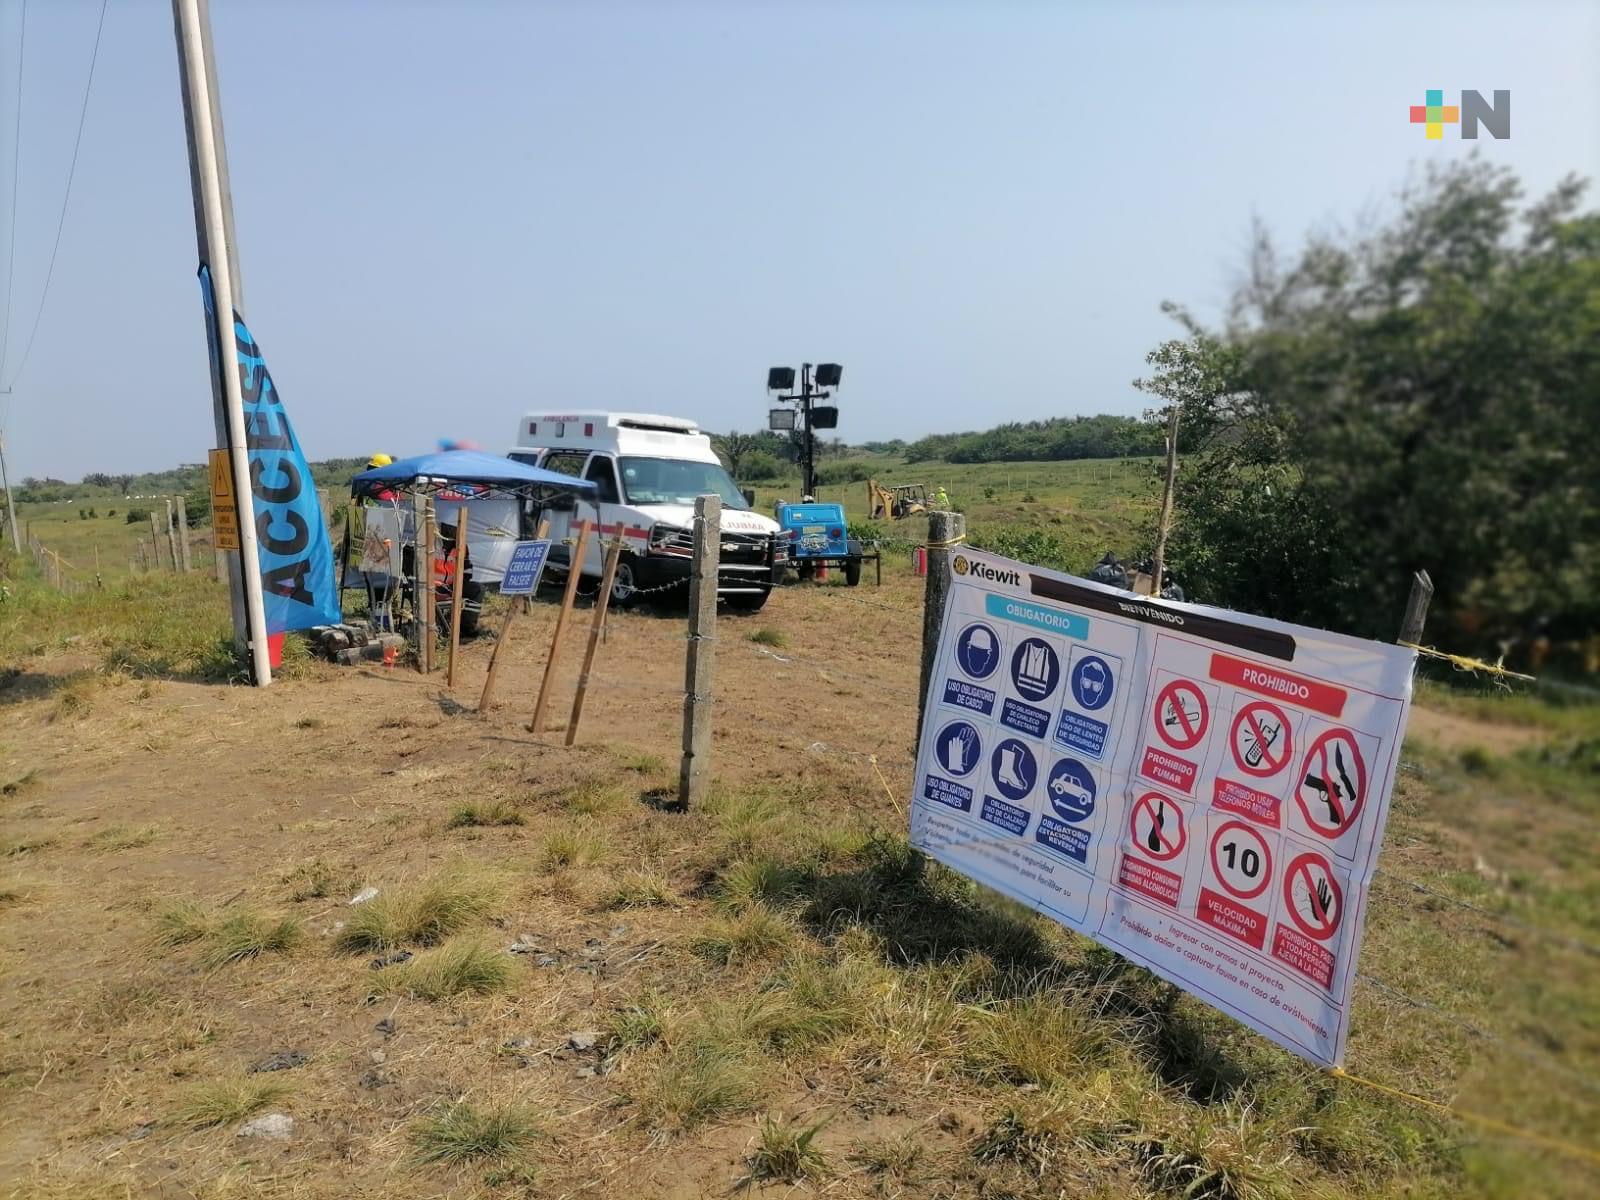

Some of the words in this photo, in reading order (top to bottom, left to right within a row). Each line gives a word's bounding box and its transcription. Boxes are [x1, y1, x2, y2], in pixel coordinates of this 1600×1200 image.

[534, 546, 544, 558] DE
[510, 560, 531, 572] CERRAR
[970, 561, 1020, 586] Kiewit
[1006, 604, 1070, 629] OBLIGATORIO
[1119, 602, 1184, 625] BIENVENIDO
[948, 682, 960, 692] USO
[960, 684, 994, 702] OBLIGATORIO
[1242, 668, 1309, 699] PROHIBIDO
[956, 694, 965, 704] DE
[965, 696, 984, 709] CASCO
[1006, 702, 1016, 710] USO
[1016, 704, 1048, 721] OBLIGATORIO
[1007, 717, 1039, 733] REFLECTANTE
[1016, 711, 1040, 725] CHALECO
[1065, 715, 1102, 733] OBLIGATORIO
[1059, 730, 1068, 738] DE
[1060, 722, 1073, 731] USO
[1082, 729, 1103, 743] LENTES
[1147, 752, 1193, 776] PROHIBIDO
[1153, 767, 1181, 785] FUMAR
[939, 780, 971, 800] OBLIGATORIO
[940, 791, 962, 807] GUANTES
[1225, 783, 1256, 801] PROHIBIDO
[984, 804, 995, 813] USO
[995, 808, 1002, 817] DE
[1003, 812, 1027, 826] CALZADO
[990, 800, 1024, 818] OBLIGATORIO
[985, 813, 993, 821] DE
[993, 816, 1021, 832] SEGURIDAD
[1042, 818, 1088, 843] OBLIGATORIO
[1039, 826, 1078, 846] ESTACIONAR
[1048, 836, 1076, 853] REVERSA
[1223, 842, 1260, 878] 10
[1208, 899, 1257, 929] VELOCIDAD
[1213, 914, 1247, 937] MÁXIMA
[1168, 924, 1199, 945] Ingresar
[1200, 942, 1214, 953] con
[1215, 949, 1238, 966] armas
[1240, 961, 1248, 971] al
[1279, 926, 1312, 950] PROHIBIDO
[1280, 938, 1285, 947] A
[1286, 940, 1303, 957] TODA
[1298, 958, 1303, 969] A
[1303, 961, 1312, 974] LA
[1120, 915, 1152, 938] Prohibido
[1154, 933, 1175, 949] dañar
[1183, 949, 1215, 969] capturar
[1215, 965, 1238, 983] fauna
[1239, 980, 1249, 989] en
[1251, 985, 1268, 999] caso
[1270, 994, 1280, 1006] de
[1282, 1003, 1329, 1039] avistamiento.
